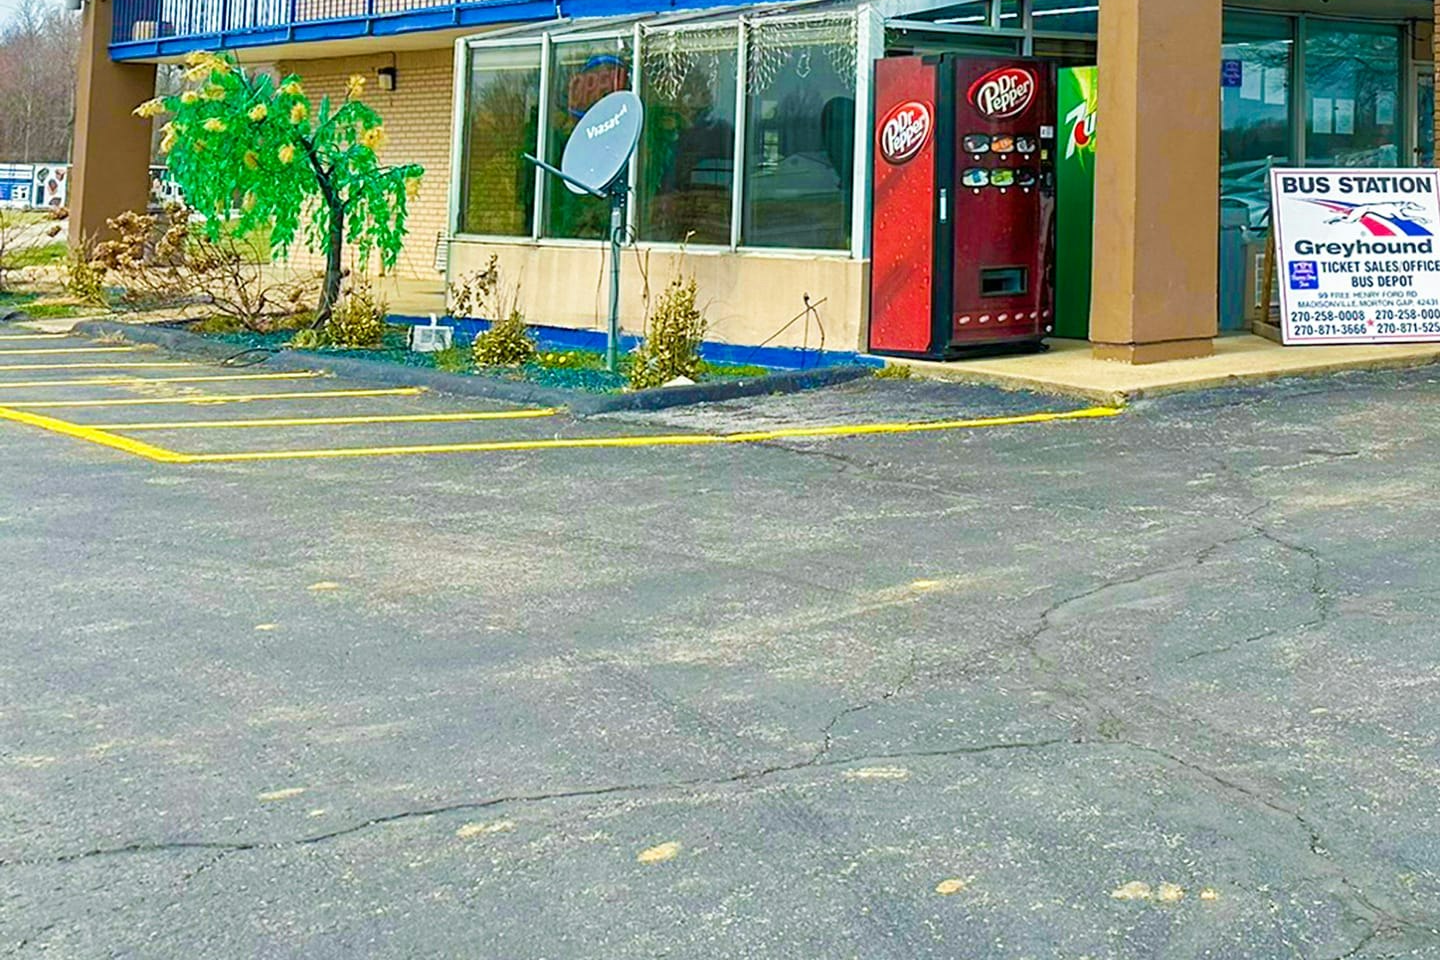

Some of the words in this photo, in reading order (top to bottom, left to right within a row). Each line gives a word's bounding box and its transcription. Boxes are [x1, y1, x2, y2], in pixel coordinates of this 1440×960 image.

[998, 75, 1018, 96] Dr
[980, 80, 1030, 115] Pepper
[897, 110, 914, 132] Dr
[883, 115, 926, 156] Pepper
[1282, 177, 1330, 194] BUS
[1338, 176, 1432, 193] STATION
[1294, 239, 1433, 258] Greyhound
[1320, 261, 1360, 273] TICKET
[1364, 261, 1399, 272] SALES
[1402, 260, 1440, 272] OFFICE
[1351, 275, 1374, 288] BUS
[1377, 275, 1413, 287] DEPOT
